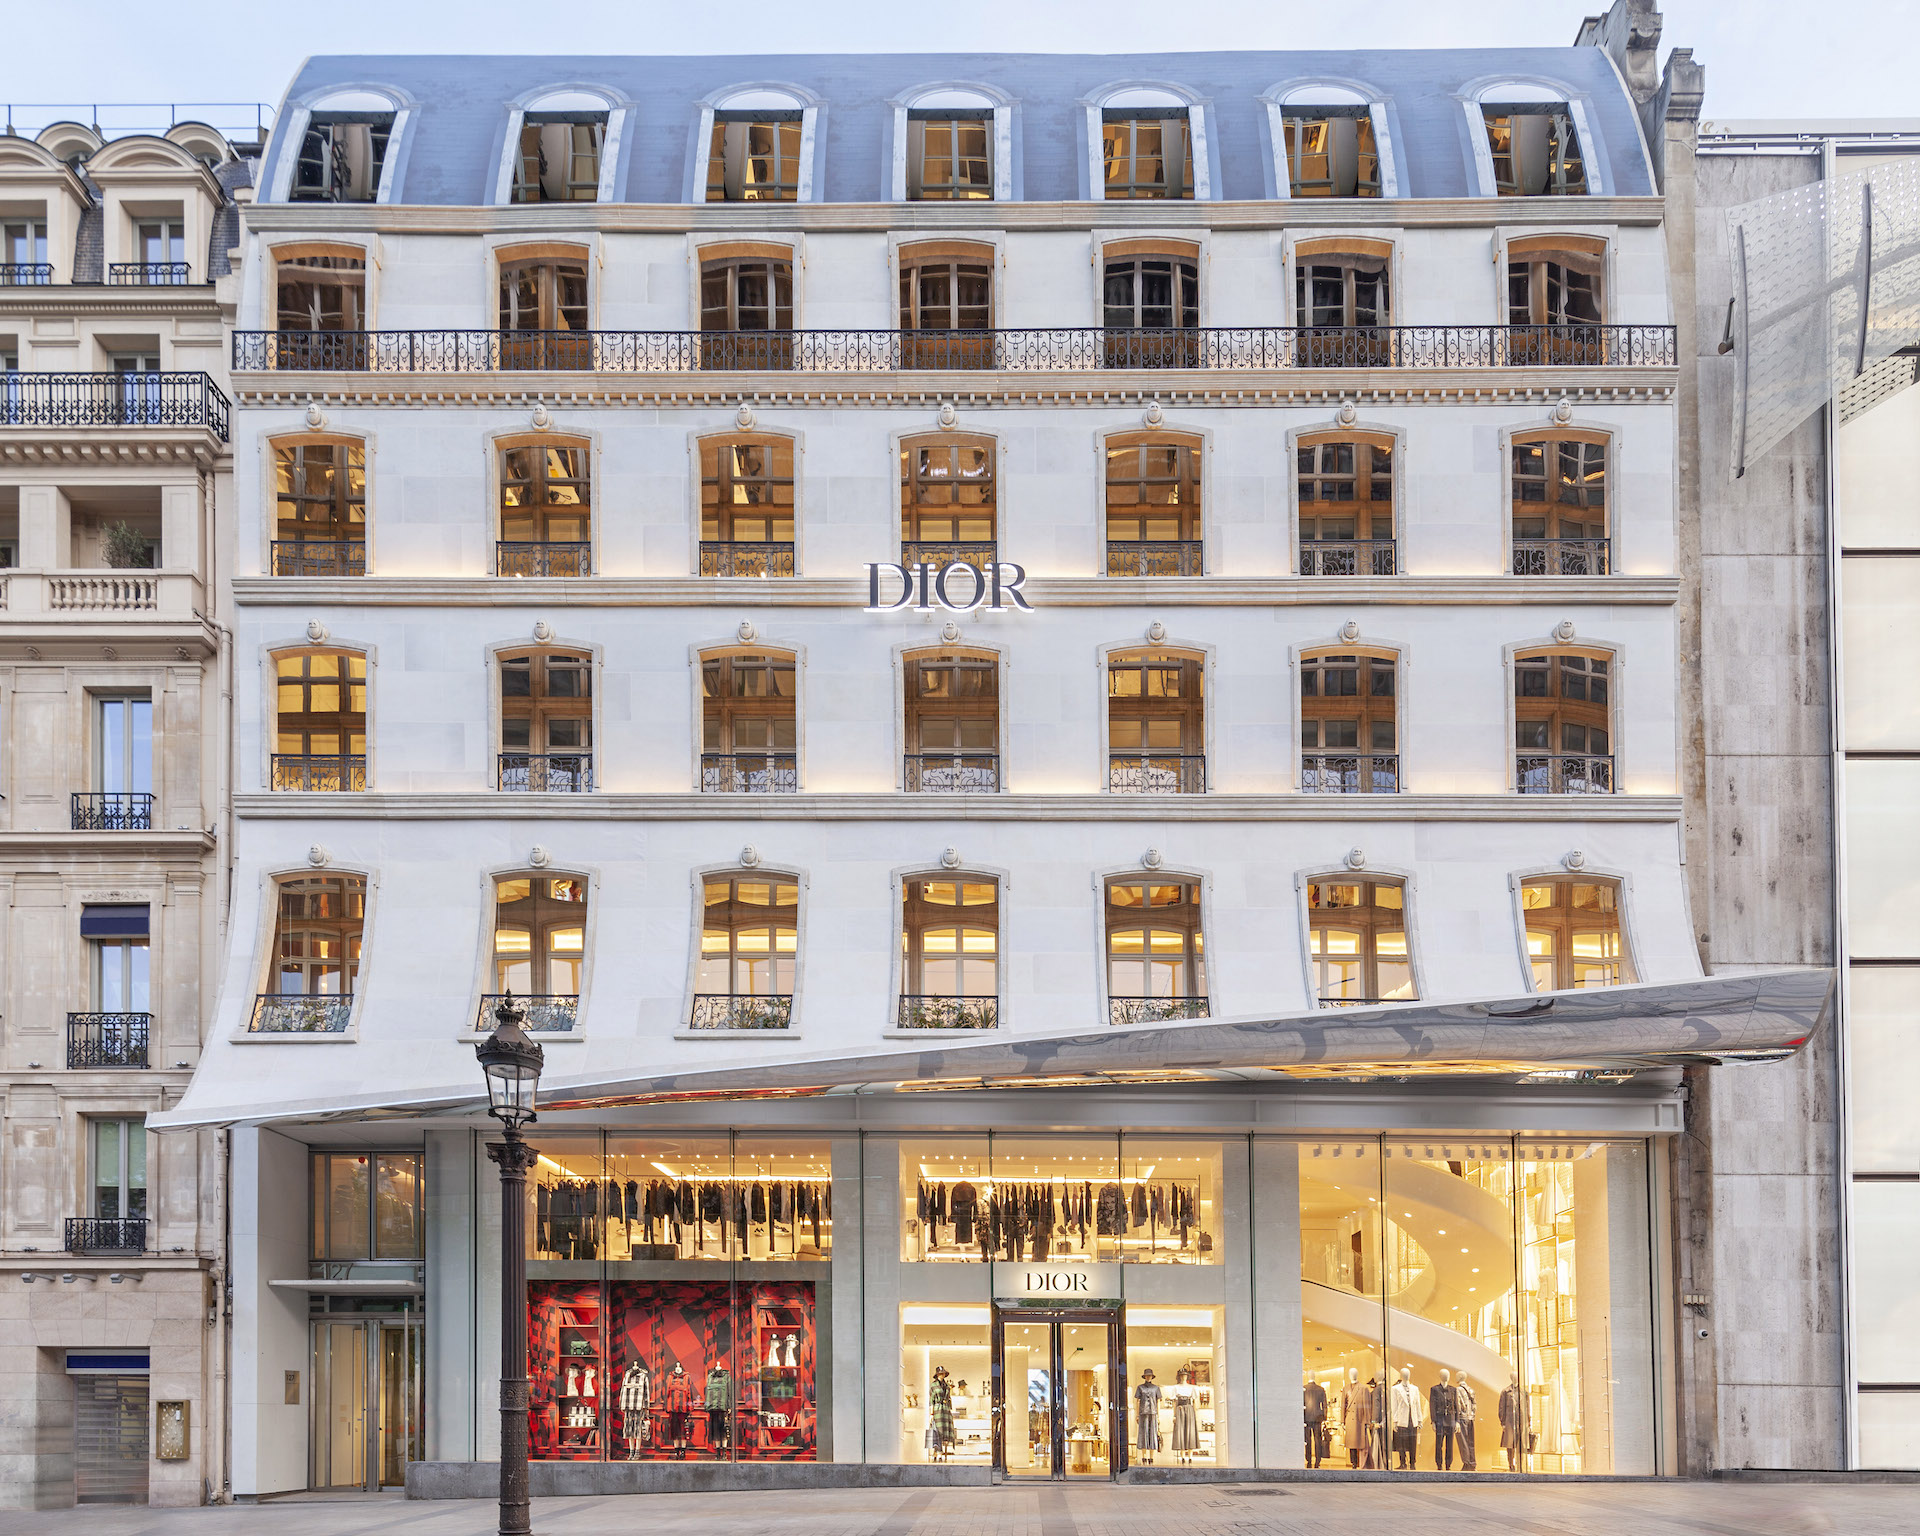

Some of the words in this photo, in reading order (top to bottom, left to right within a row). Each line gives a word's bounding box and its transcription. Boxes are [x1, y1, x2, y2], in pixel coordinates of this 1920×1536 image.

[863, 562, 1035, 613] DIOR
[319, 1262, 355, 1280] 127
[1025, 1272, 1089, 1292] DIOR
